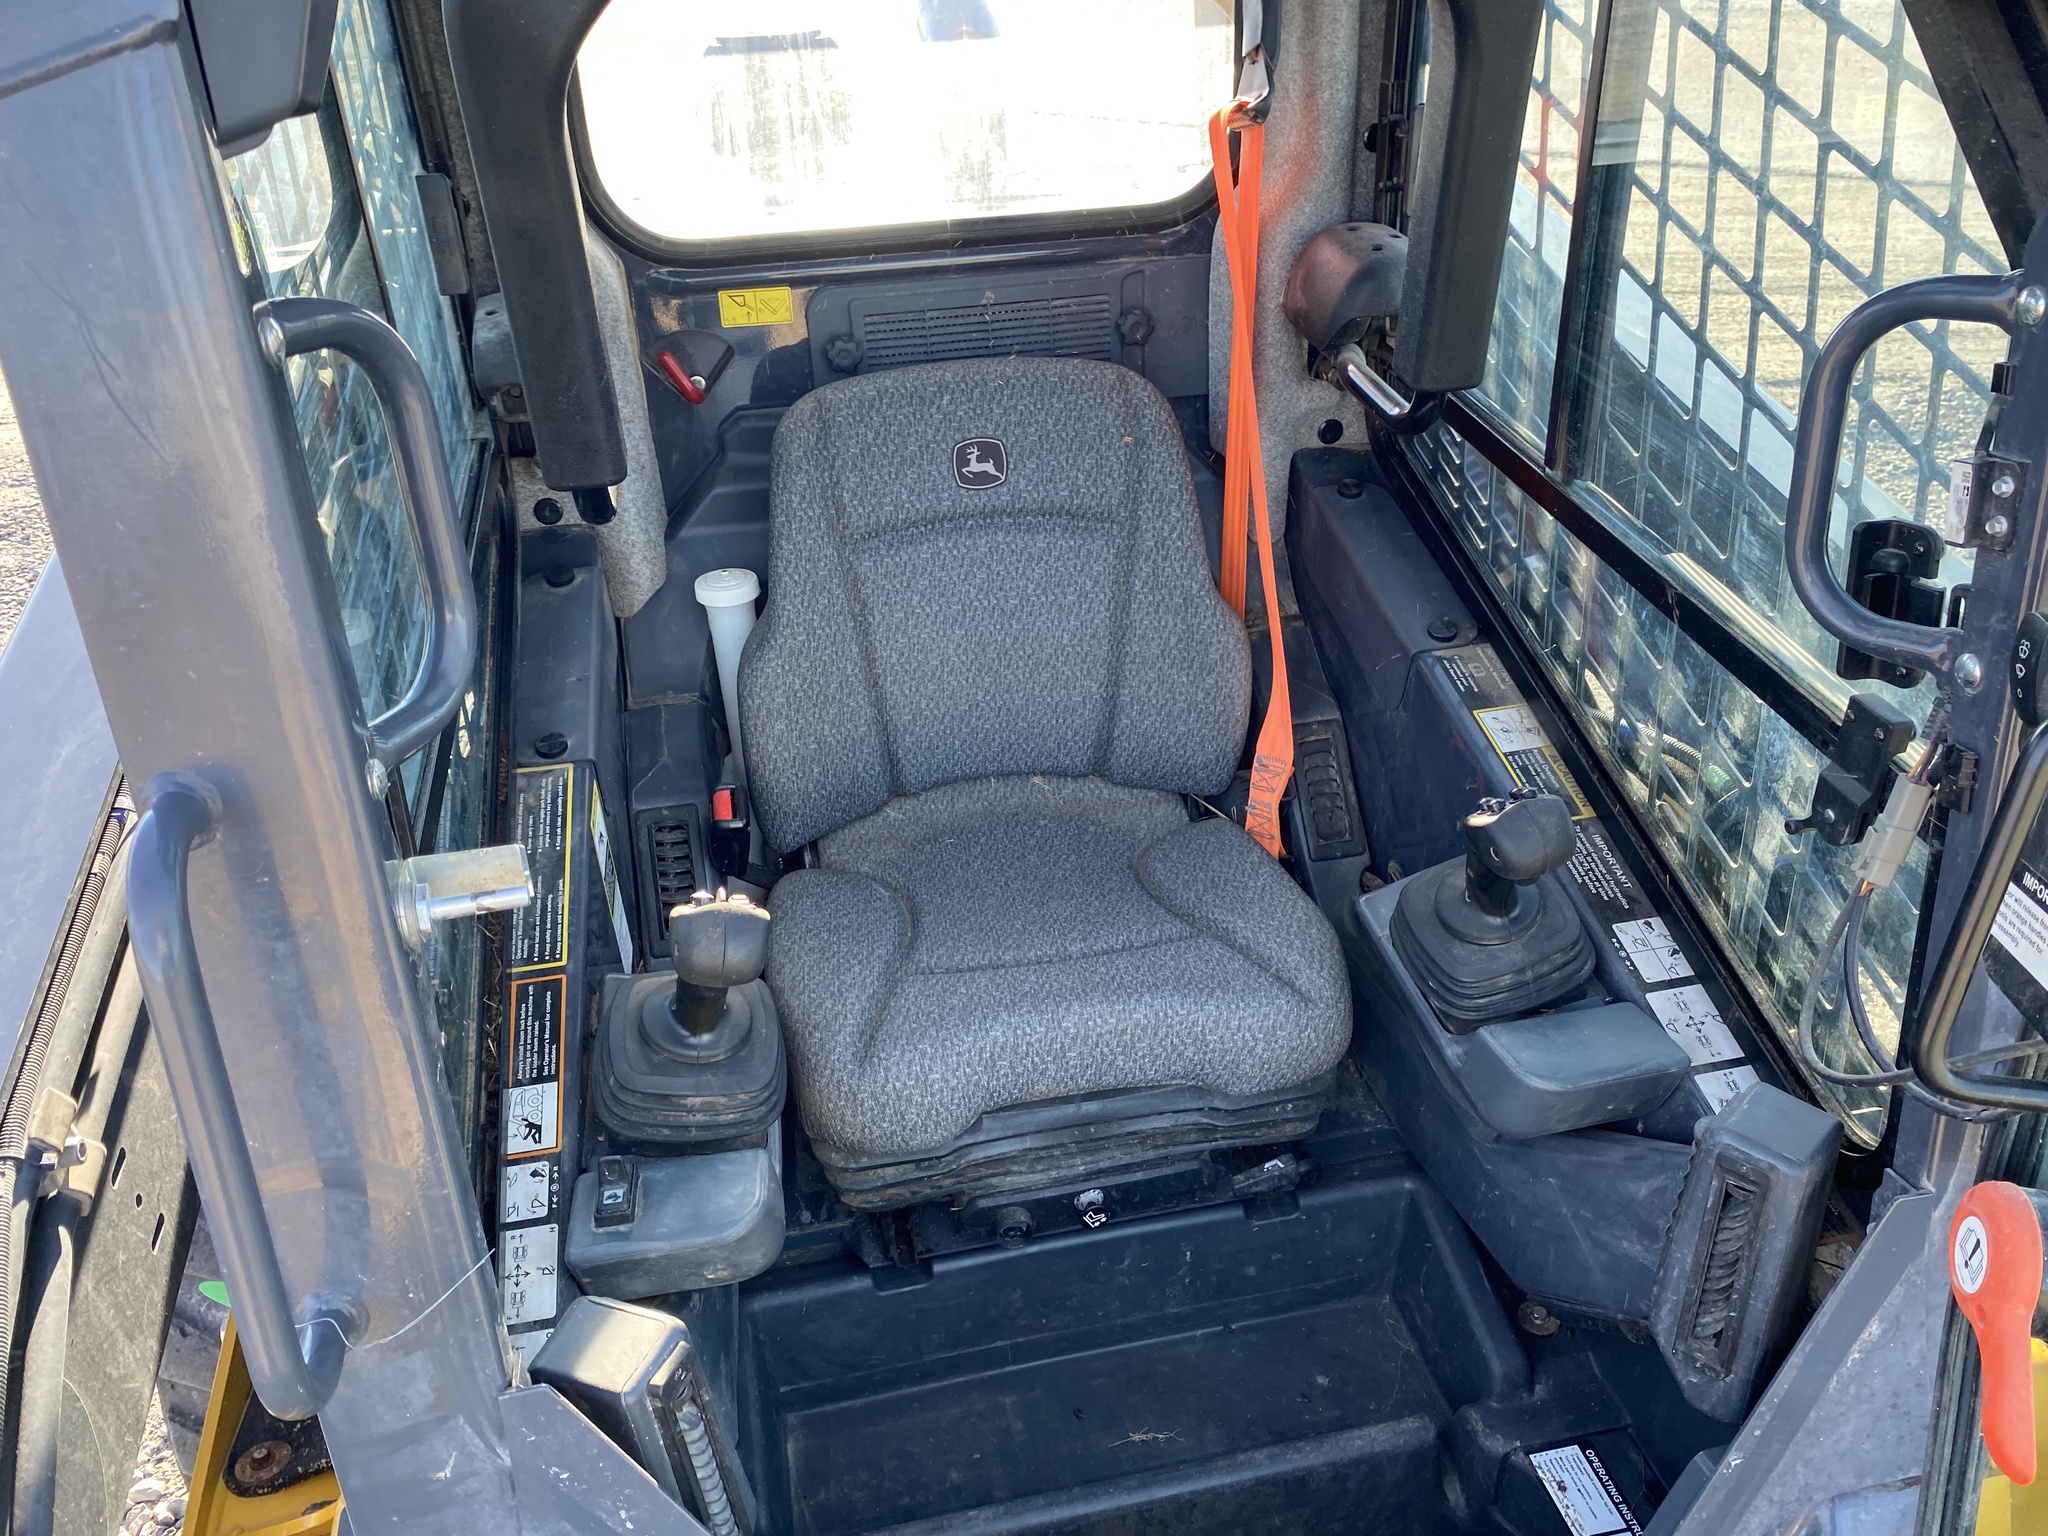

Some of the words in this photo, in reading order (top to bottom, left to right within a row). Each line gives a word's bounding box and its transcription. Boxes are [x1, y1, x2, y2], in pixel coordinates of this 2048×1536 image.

[1532, 748, 1544, 766] Avoid
[1542, 765, 1559, 788] Overturn
[1556, 764, 1590, 808] CAUTION
[1567, 861, 1582, 884] controls.
[1578, 832, 1594, 852] prevent
[1591, 852, 1607, 874] damage
[1610, 880, 1630, 909] hydraulics
[1590, 862, 1614, 898] temperatures
[1592, 834, 1632, 888] IMPORTANT
[1583, 875, 1597, 894] before
[1588, 871, 1596, 881] run
[1598, 887, 1609, 901] slow
[2006, 890, 2014, 899] oor
[2014, 894, 2023, 906] will
[2022, 904, 2040, 923] release
[2040, 919, 2048, 932] fro
[2011, 908, 2028, 926] orange
[2027, 921, 2046, 944] handles
[1994, 920, 2020, 947] e-assembly.
[1998, 909, 2008, 921] ools
[2008, 920, 2016, 930] are
[2016, 926, 2036, 948] required
[2036, 942, 2044, 954] for
[1586, 1450, 1622, 1502] OPERATING
